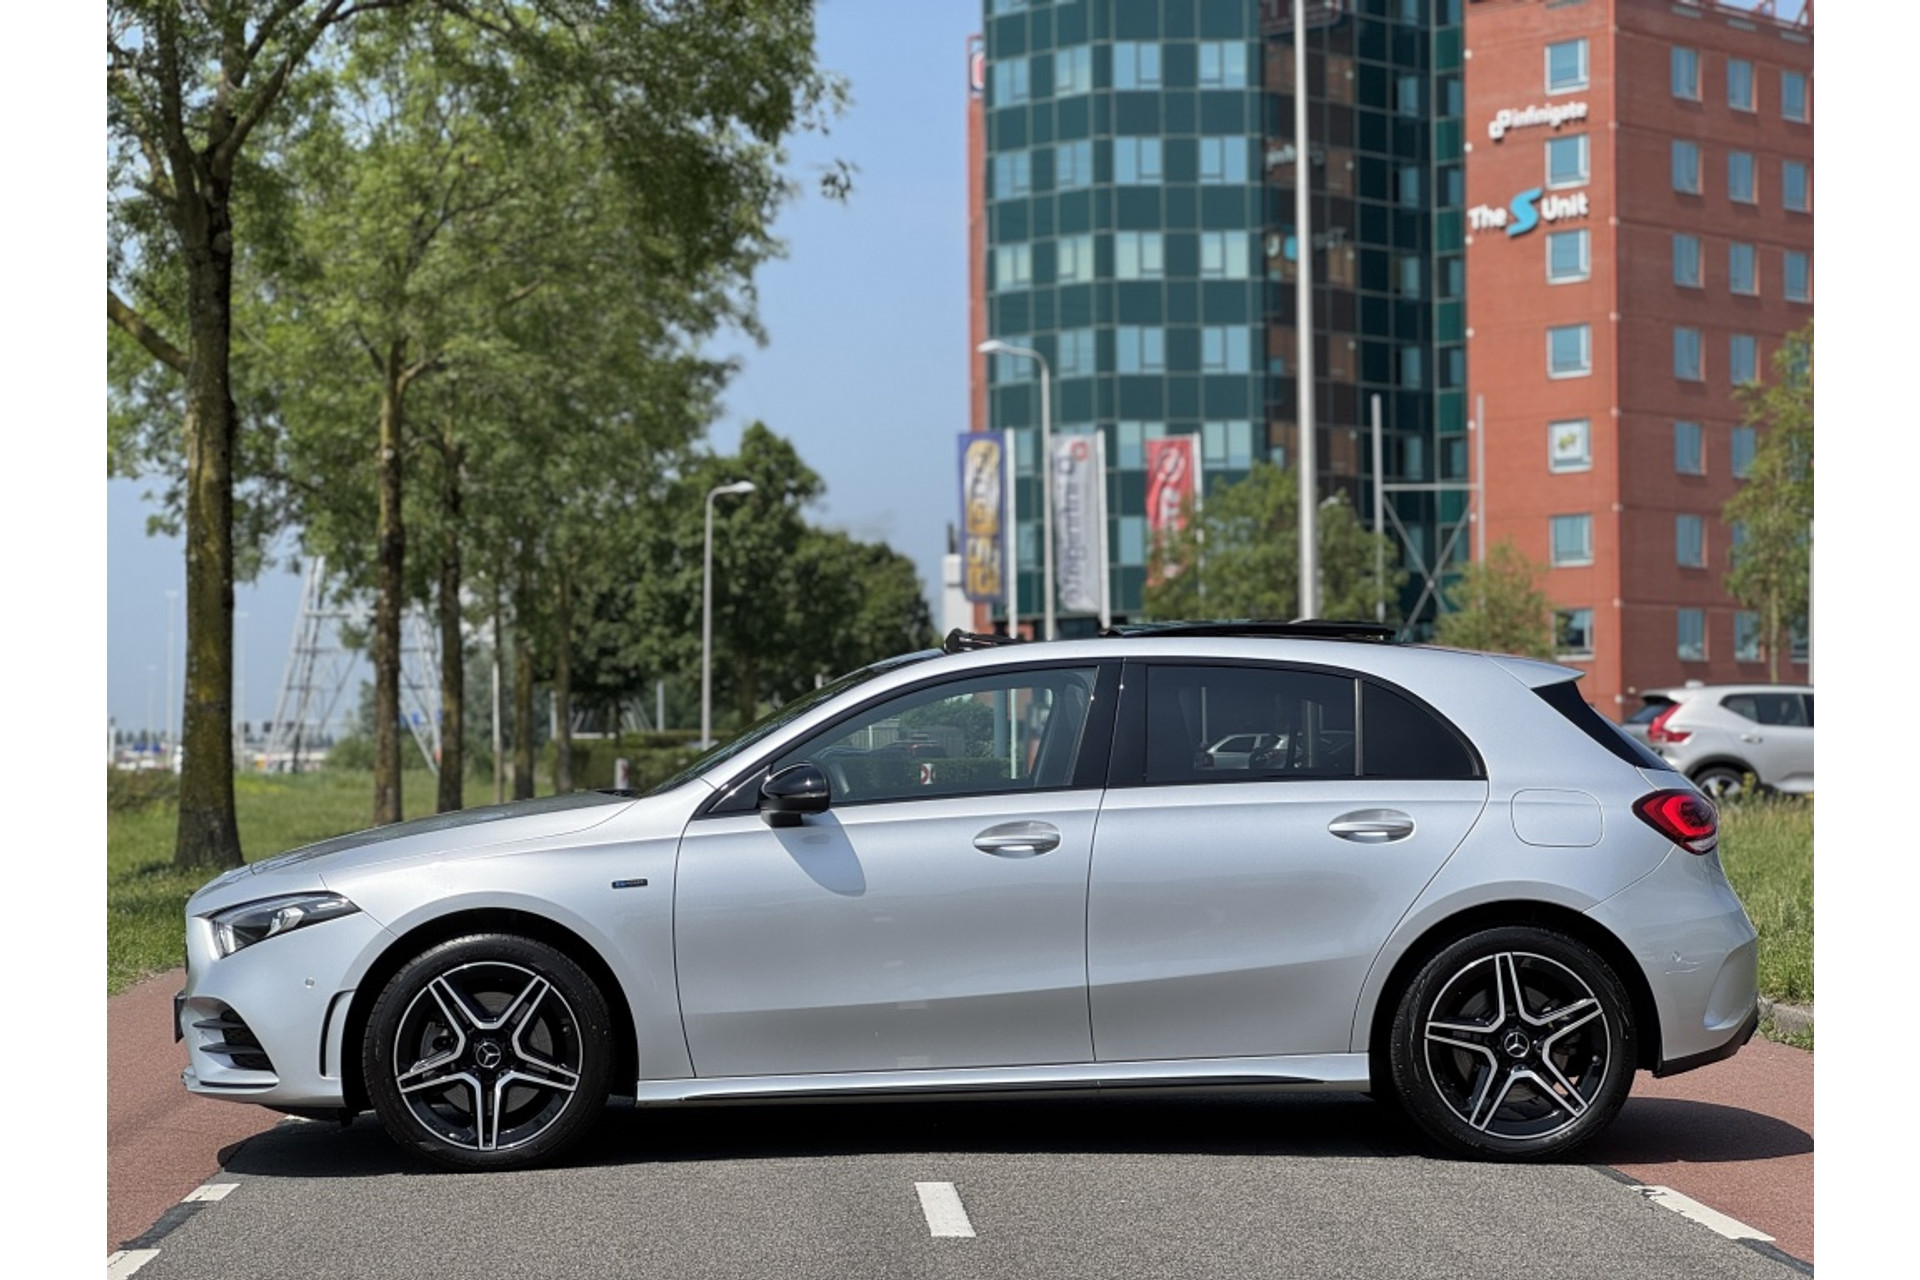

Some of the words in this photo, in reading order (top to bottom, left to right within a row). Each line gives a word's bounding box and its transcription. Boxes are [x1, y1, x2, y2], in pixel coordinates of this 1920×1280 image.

[1468, 204, 1507, 230] The
[1505, 187, 1543, 237] S
[1541, 192, 1588, 221] Unit
